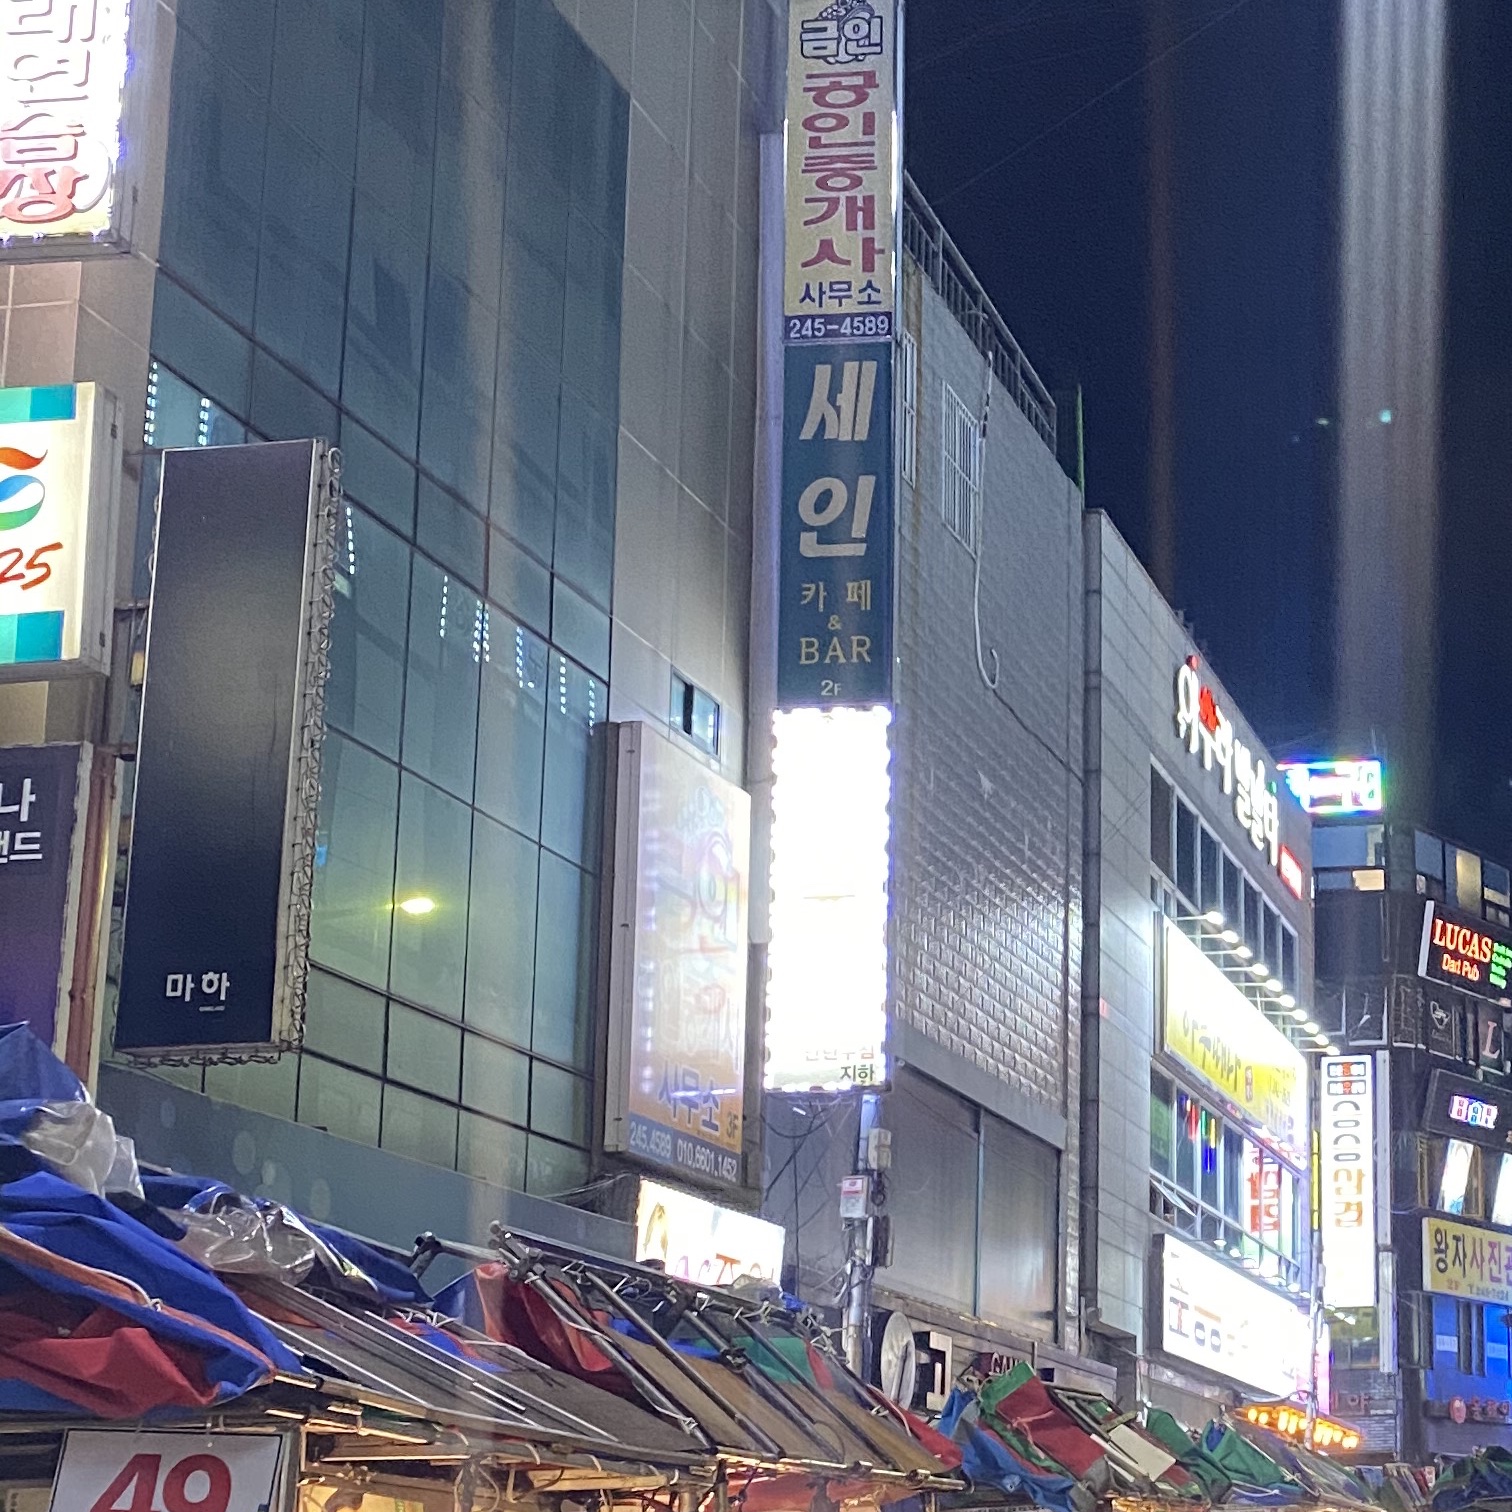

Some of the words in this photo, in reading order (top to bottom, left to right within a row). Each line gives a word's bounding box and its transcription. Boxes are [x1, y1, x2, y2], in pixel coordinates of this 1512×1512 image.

[801, 15, 883, 58] 금인
[801, 70, 885, 274] 공인중개사
[799, 279, 882, 308] 사무소
[789, 317, 890, 339] 245-4589
[798, 361, 877, 557] 세인
[801, 580, 872, 612] 카페
[800, 635, 872, 665] BAR
[1433, 918, 1493, 963] LUCAS
[165, 972, 230, 1002] 마하
[1461, 962, 1480, 982] Pub
